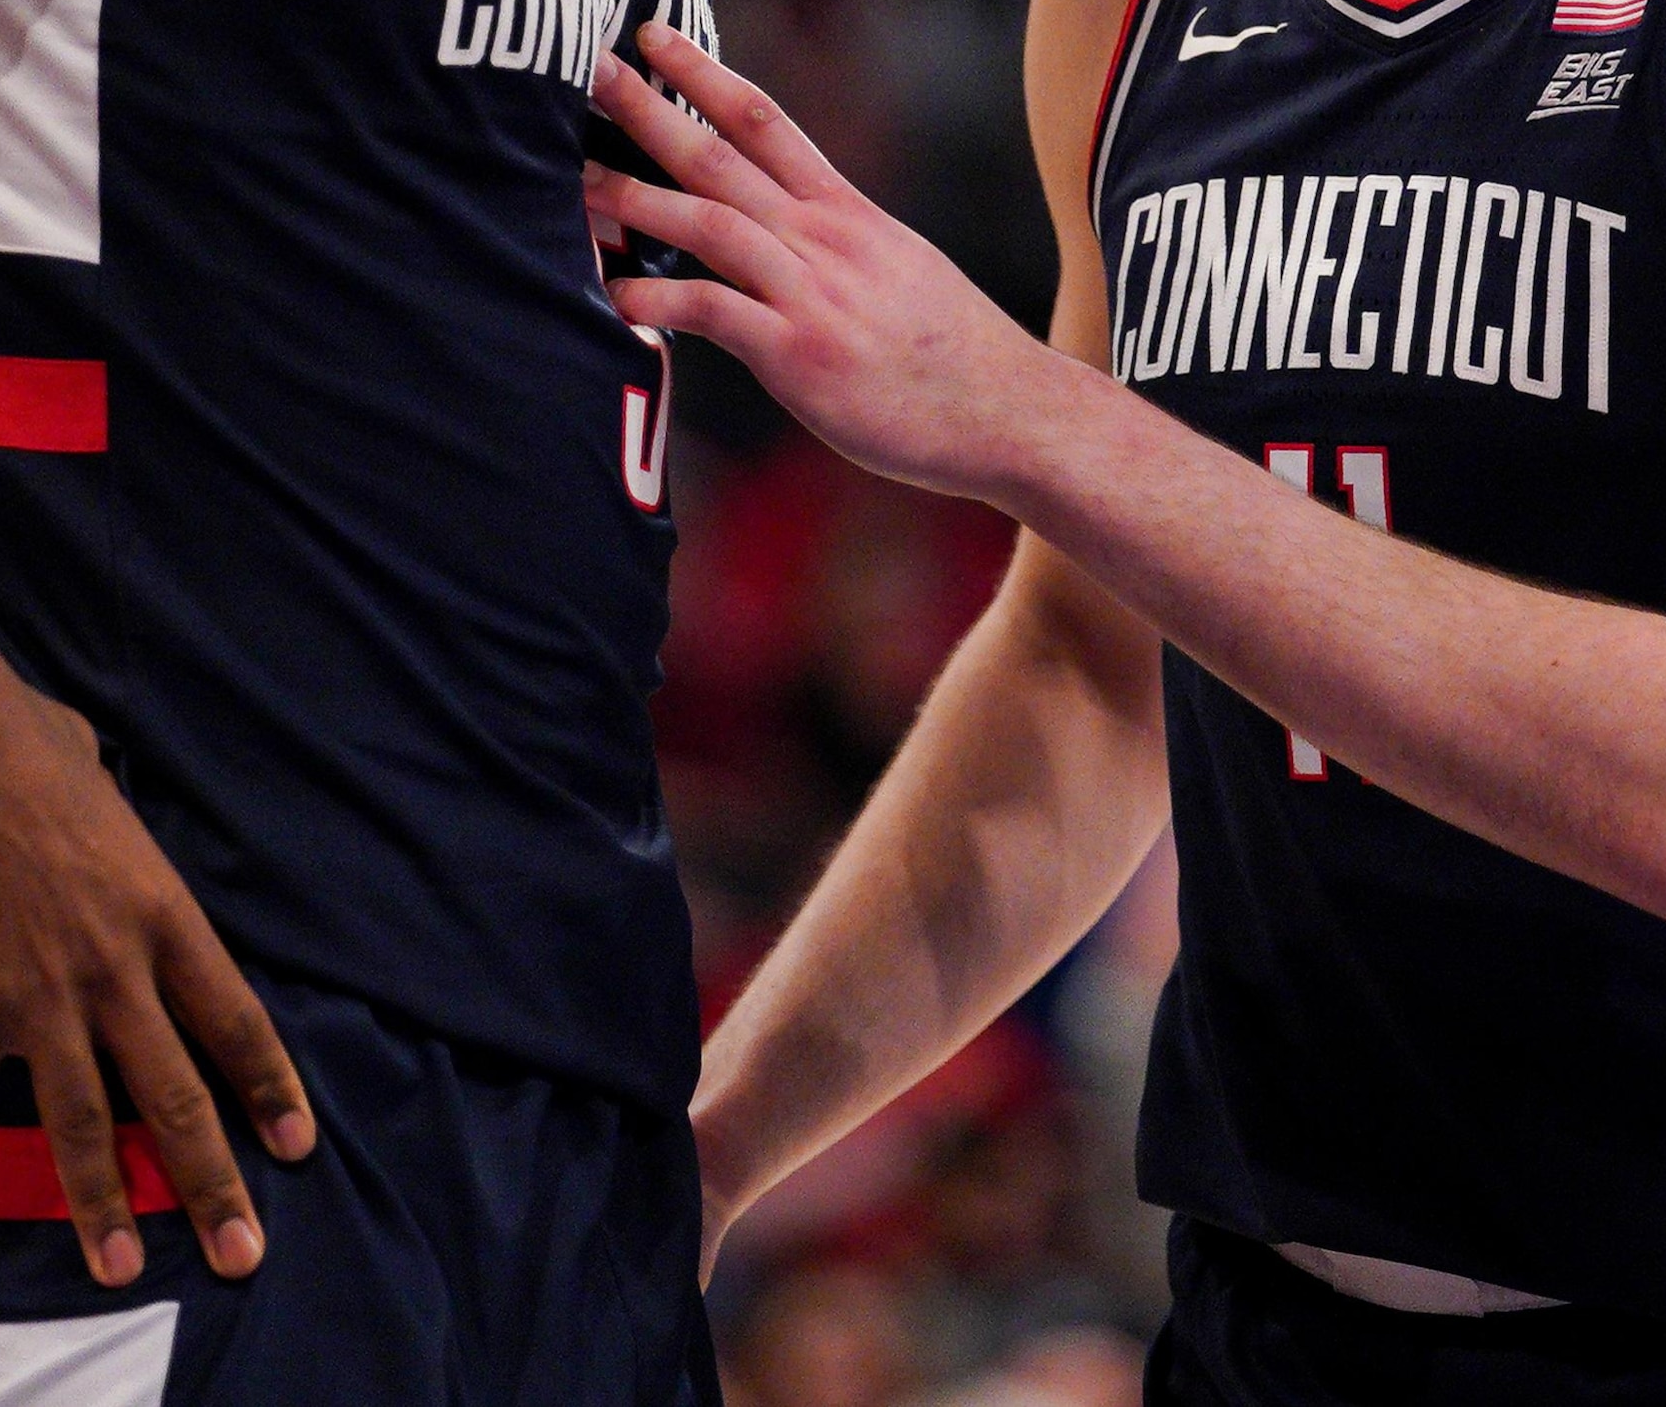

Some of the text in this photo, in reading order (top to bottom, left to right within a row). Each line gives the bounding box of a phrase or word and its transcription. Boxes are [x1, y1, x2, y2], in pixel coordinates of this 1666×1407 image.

[1551, 48, 1627, 80] BIG
[1536, 73, 1635, 107] EAST
[1112, 174, 1627, 414] CONNECTICUT
